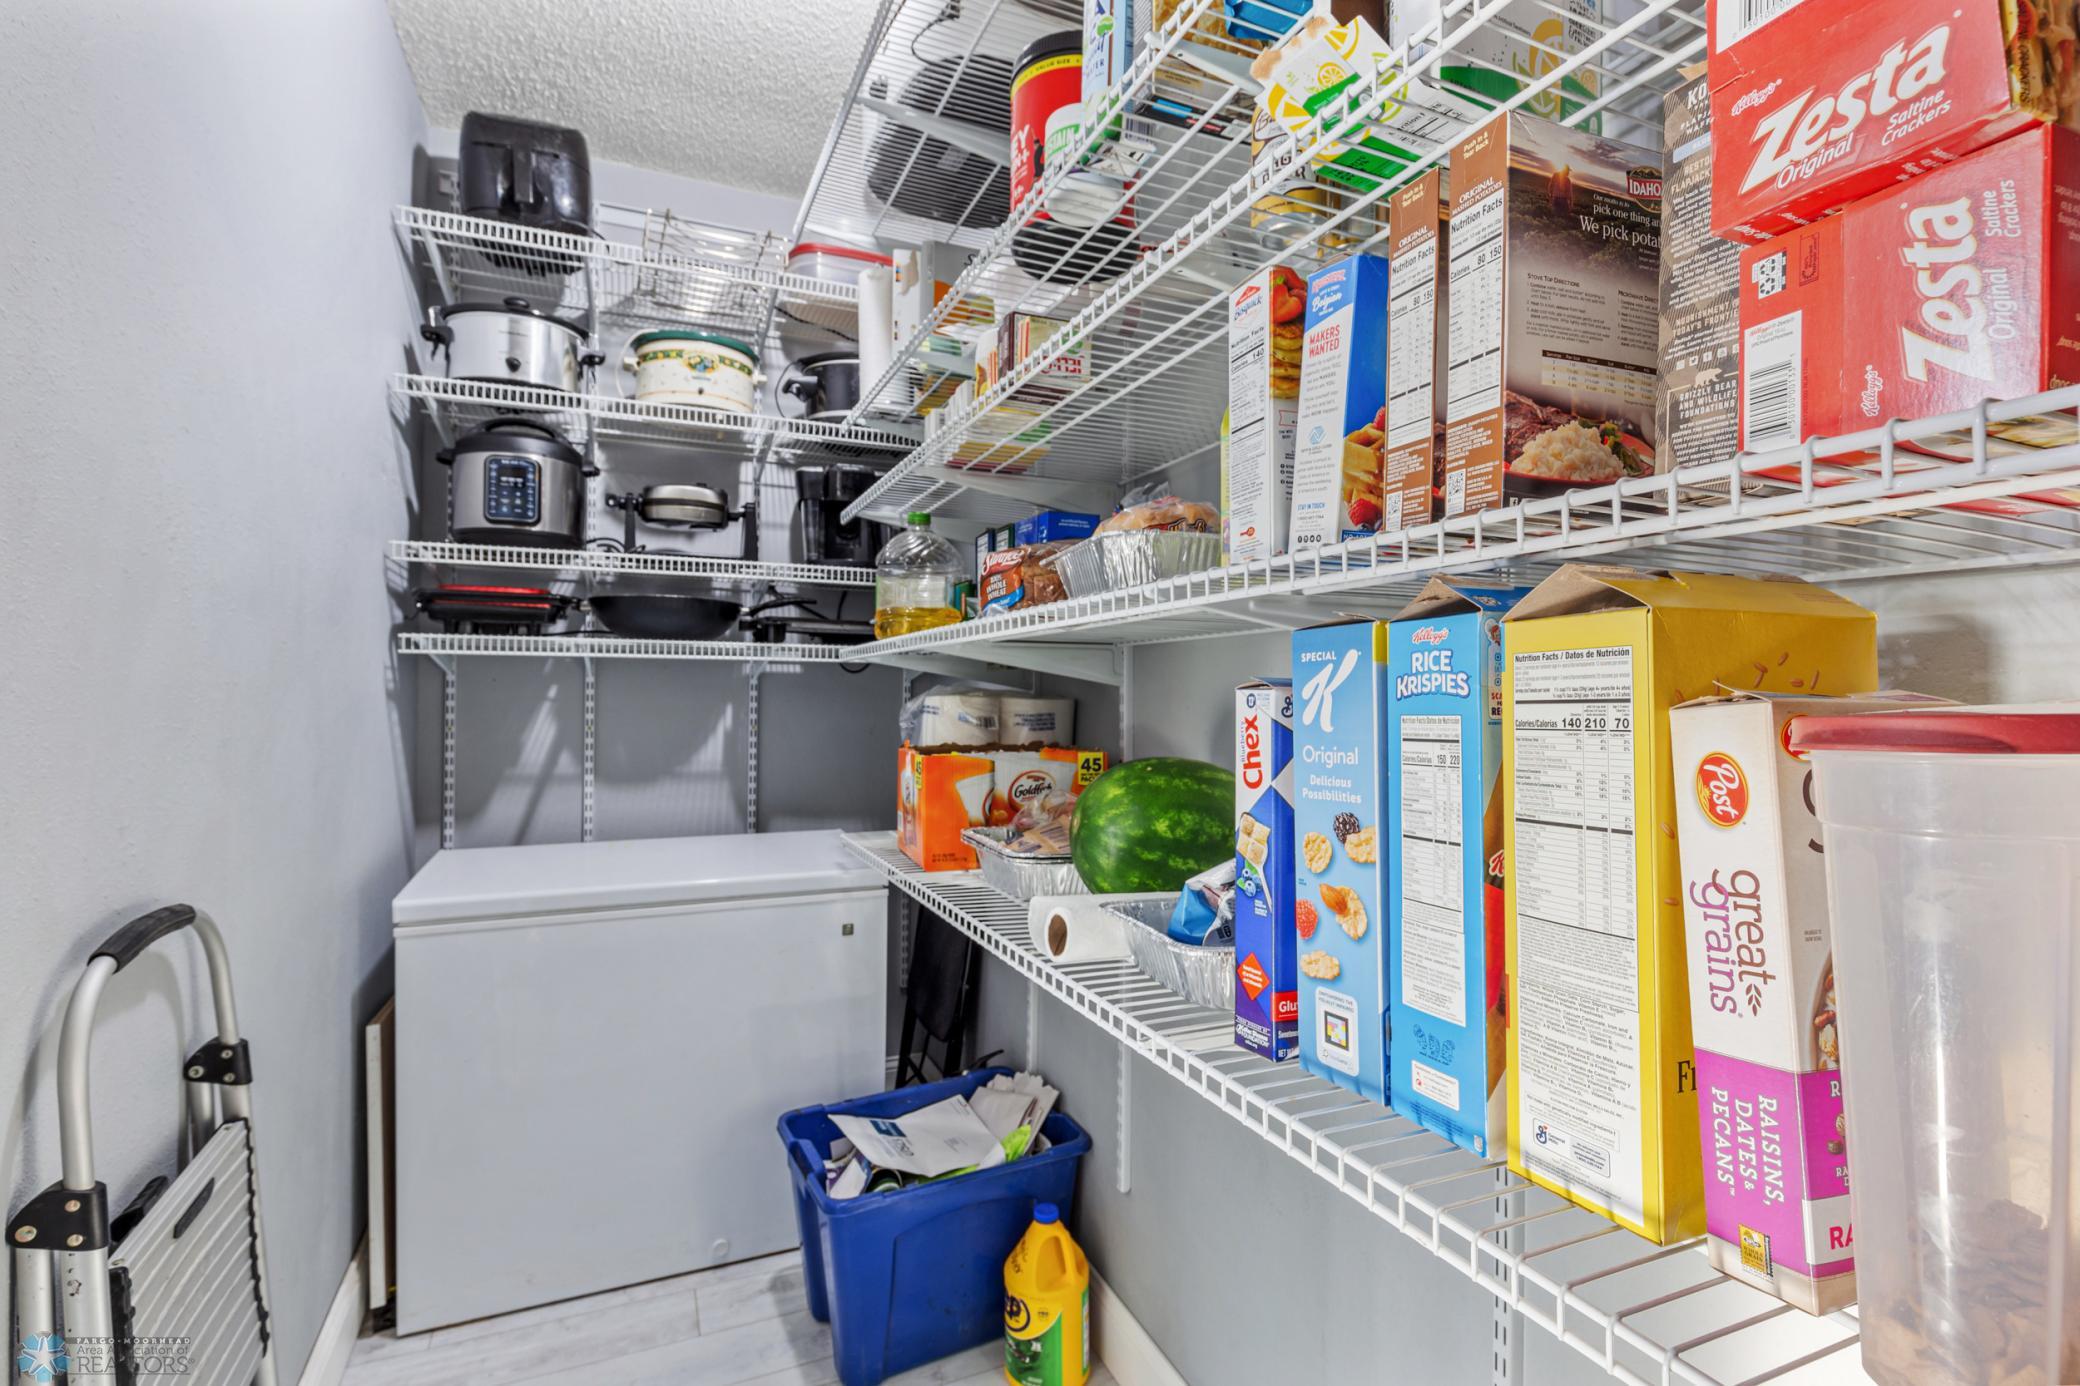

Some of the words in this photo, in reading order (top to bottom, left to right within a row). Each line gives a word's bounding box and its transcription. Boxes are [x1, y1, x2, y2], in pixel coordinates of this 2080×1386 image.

[1738, 25, 1951, 195] Zesta
[1881, 98, 1952, 146] Crackers
[1887, 88, 1945, 130] Saltine
[1777, 134, 1853, 190] Original
[1459, 177, 1494, 203] ORIGINAL
[1475, 181, 1502, 203] POTATOES
[1451, 211, 1481, 234] Nutrition
[1482, 197, 1503, 216] Facts
[1593, 203, 1611, 217] pick
[1612, 208, 1628, 219] one
[1630, 211, 1650, 227] thing
[1984, 189, 2000, 238] Saltine
[2002, 178, 2021, 238] Crackers
[1399, 225, 1428, 248] ORIGINAL
[1579, 214, 1599, 234] We
[1602, 222, 1629, 241] pick
[1392, 255, 1417, 276] Nutrition
[1417, 245, 1434, 260] Facts
[1477, 254, 1486, 266] 80
[1489, 245, 1502, 260] 150
[1900, 197, 1997, 384] Zesta
[1988, 267, 2018, 341] Original
[1309, 325, 1340, 346] MAKERS
[1309, 338, 1340, 359] WANTED
[1862, 366, 1885, 417] Kellogg's
[1411, 626, 1449, 644] Kellogg's
[1301, 651, 1337, 662] SPECIAL
[1411, 650, 1452, 674] RICE
[1515, 655, 1541, 663] Nutrition
[1542, 653, 1559, 661] Facts
[1565, 651, 1584, 660] Datos
[1585, 650, 1595, 659] de
[1596, 648, 1630, 658] Nutrición
[1301, 649, 1359, 733] K
[1396, 672, 1470, 701] KRISPIES
[1515, 719, 1558, 728] Calories/Calorias
[1562, 718, 1582, 728] 140
[1585, 718, 1606, 728] 210
[1614, 718, 1630, 729] 70
[1081, 758, 1102, 772] 45
[1242, 714, 1263, 790] Chex
[1302, 745, 1359, 768] Original
[1437, 754, 1446, 765] 150
[1450, 755, 1460, 765] 220
[1302, 788, 1362, 804] Possibilities
[1309, 774, 1352, 788] Delicious
[1703, 763, 1740, 821] Post
[1712, 869, 1776, 985] great
[1689, 879, 1738, 1015] grains
[1712, 1087, 1735, 1189] PECANS
[1735, 1099, 1757, 1177] DATES
[1758, 1095, 1784, 1205] RAISINS,
